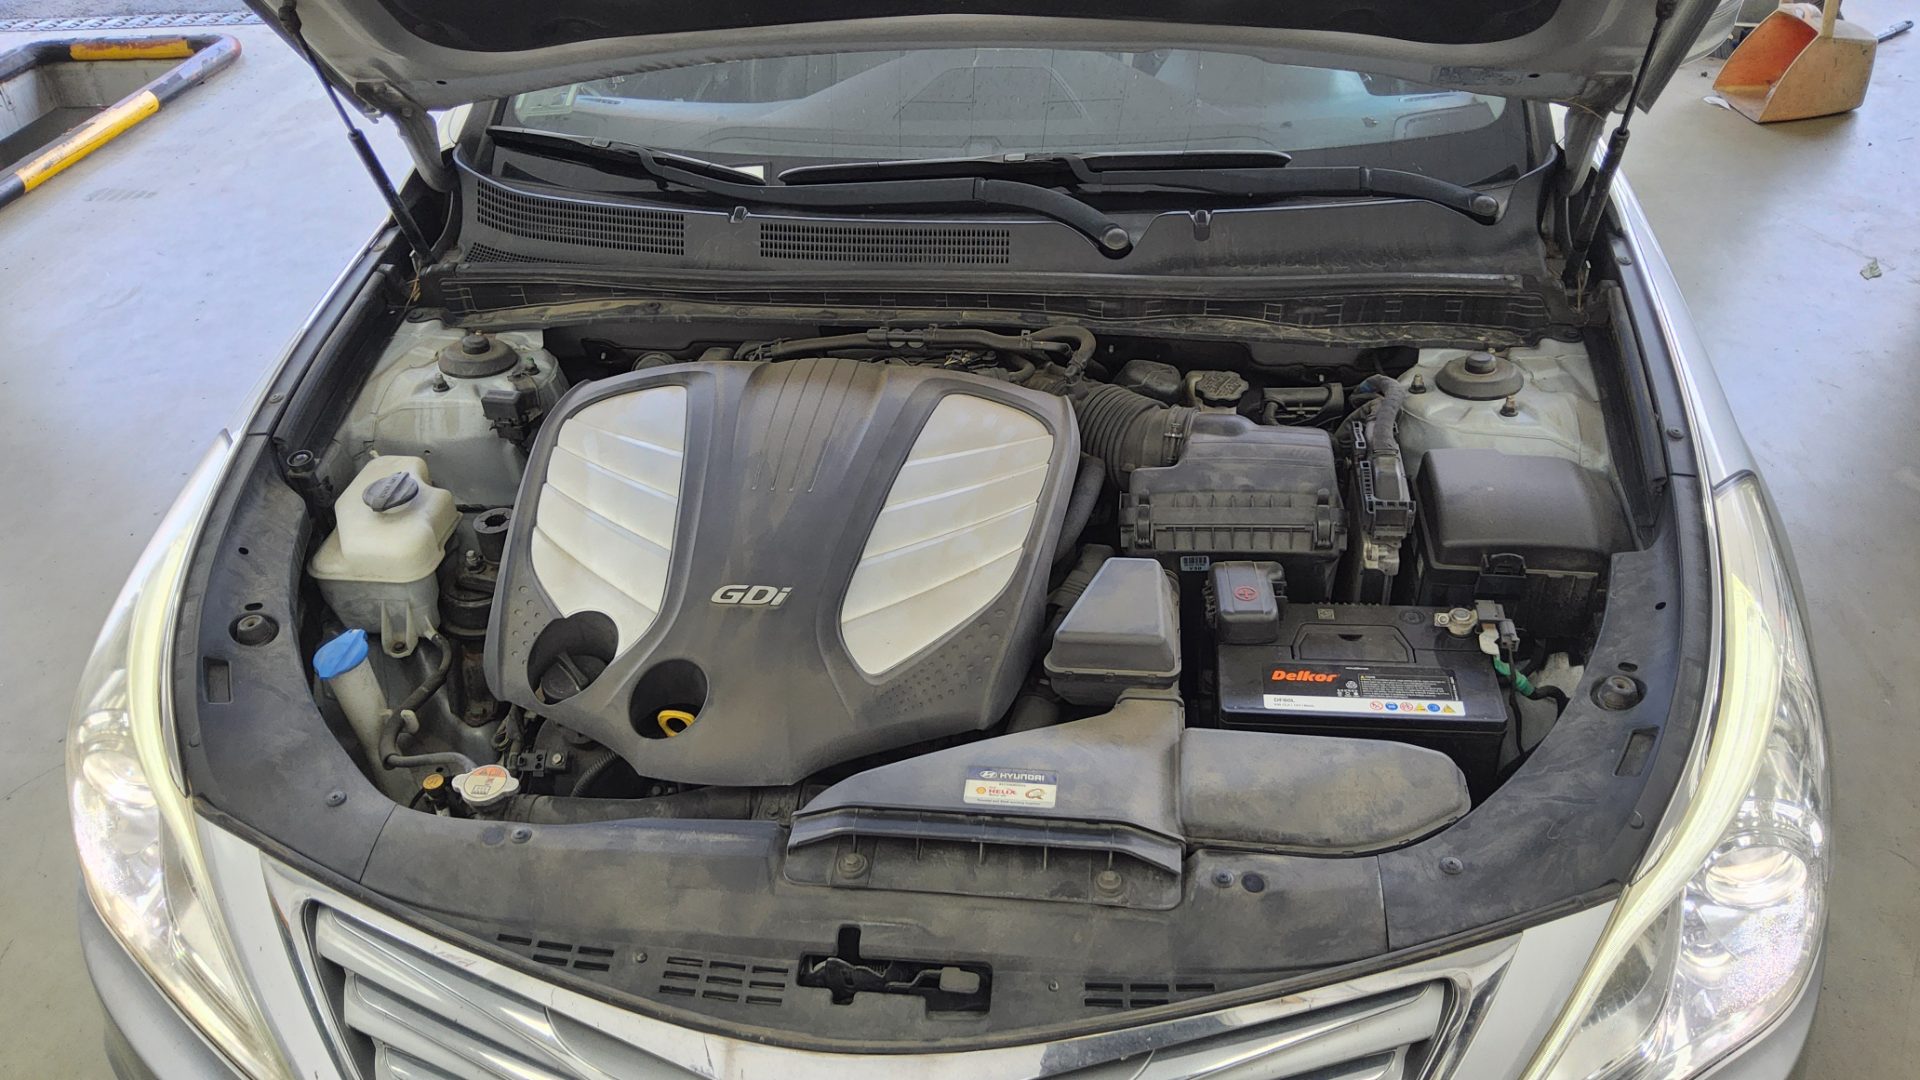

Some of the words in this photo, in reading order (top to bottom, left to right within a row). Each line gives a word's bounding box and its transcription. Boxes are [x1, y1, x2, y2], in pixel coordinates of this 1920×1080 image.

[711, 584, 793, 605] GDi
[1271, 670, 1338, 683] Delkor
[1000, 772, 1045, 781] HYUNDAI
